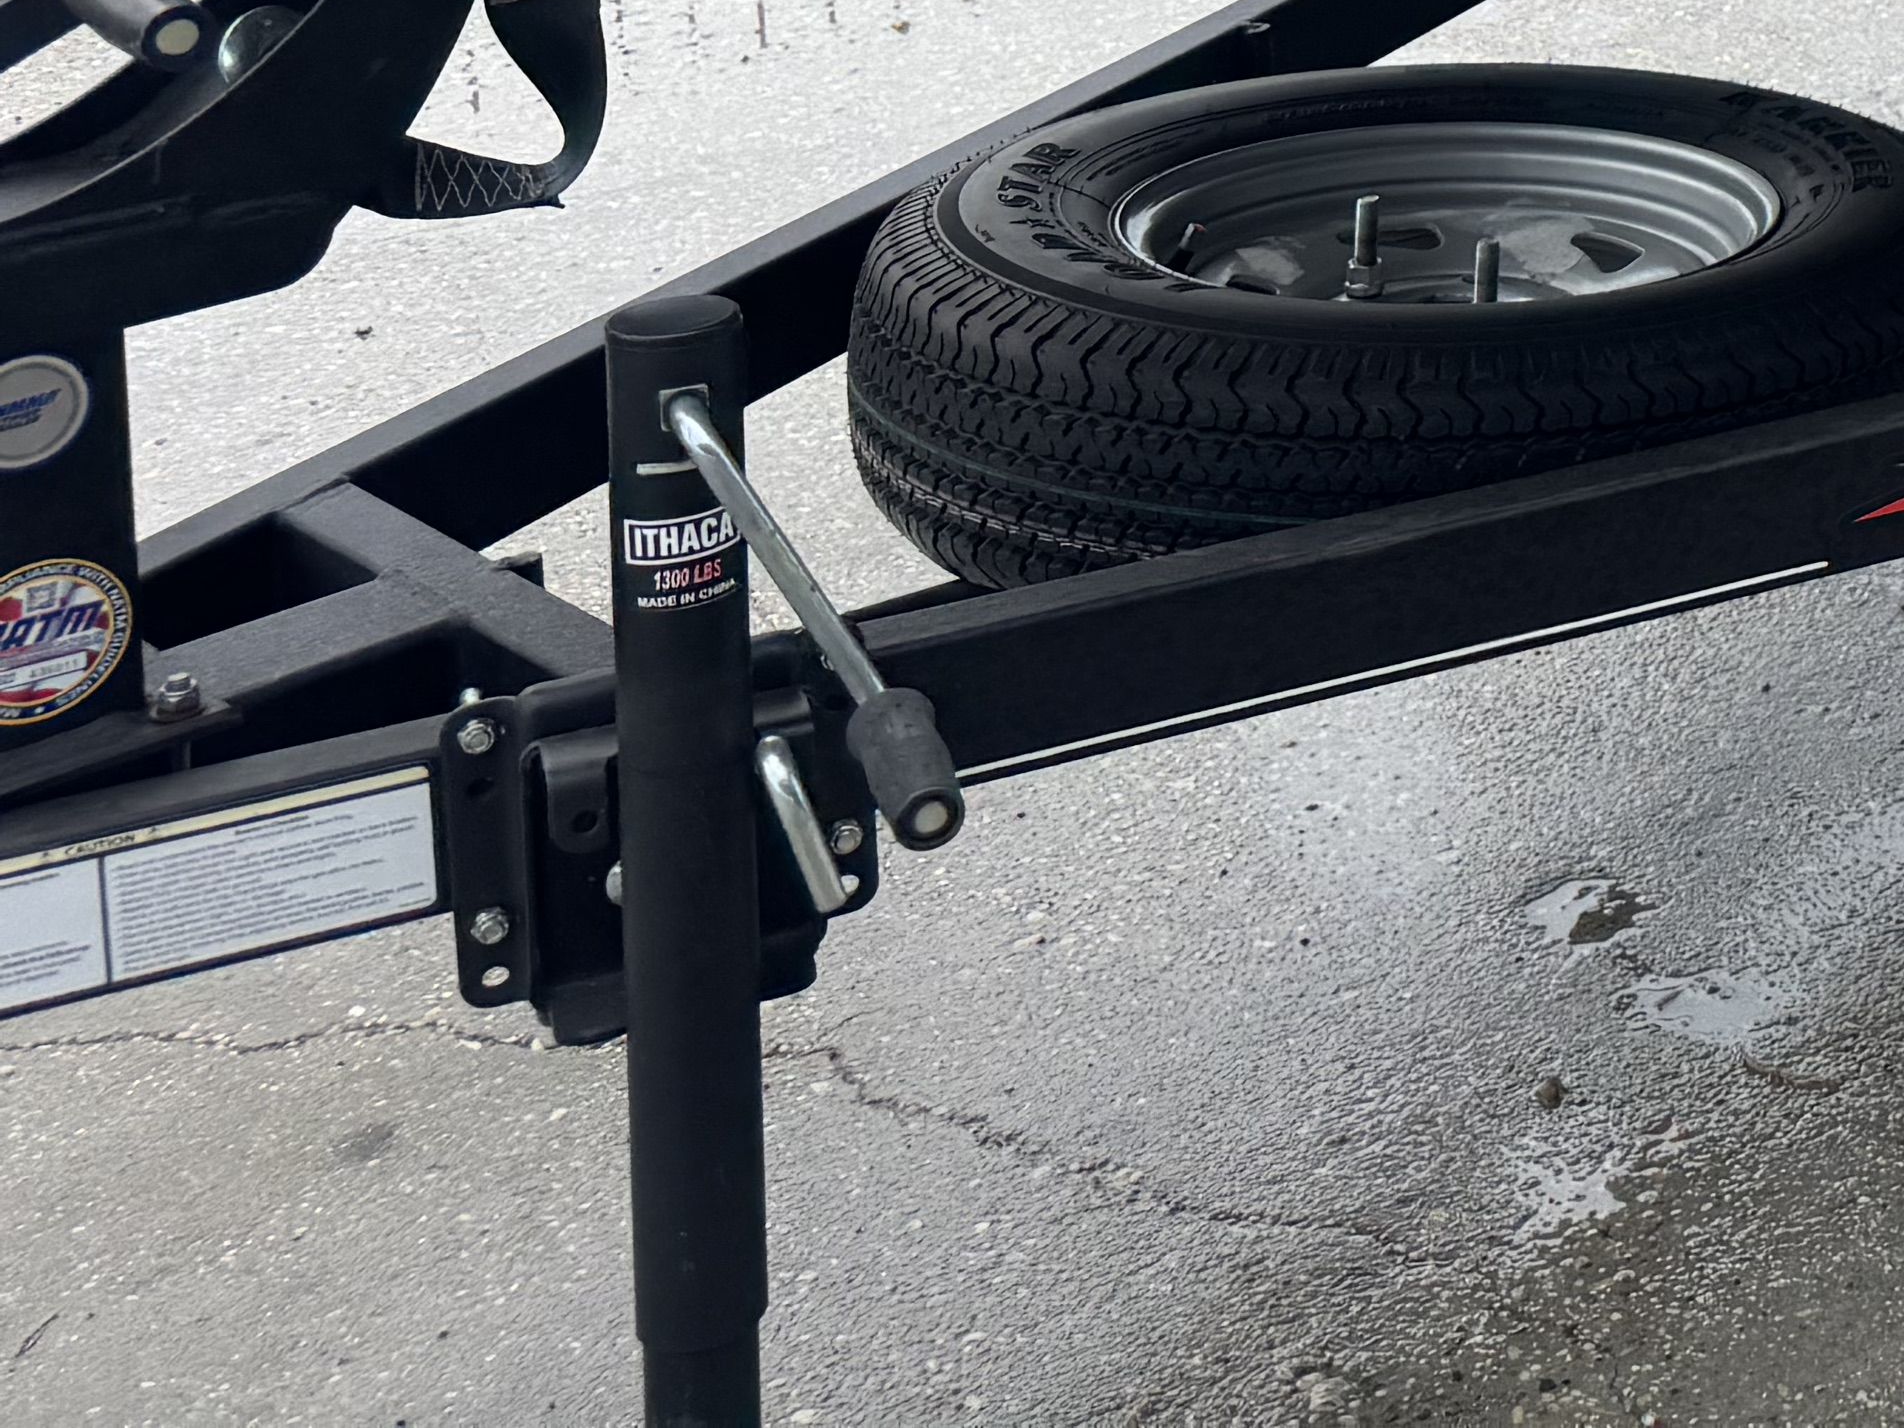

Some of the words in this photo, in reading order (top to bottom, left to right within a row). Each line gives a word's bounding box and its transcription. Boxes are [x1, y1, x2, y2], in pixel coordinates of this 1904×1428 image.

[996, 141, 1080, 213] STAR
[634, 511, 735, 557] ITHACA
[653, 568, 690, 591] 1300
[693, 558, 721, 584] LBS
[637, 595, 677, 608] MADE
[680, 591, 695, 606] IN
[699, 577, 736, 600] CHINA
[65, 834, 135, 855] CAUTION
